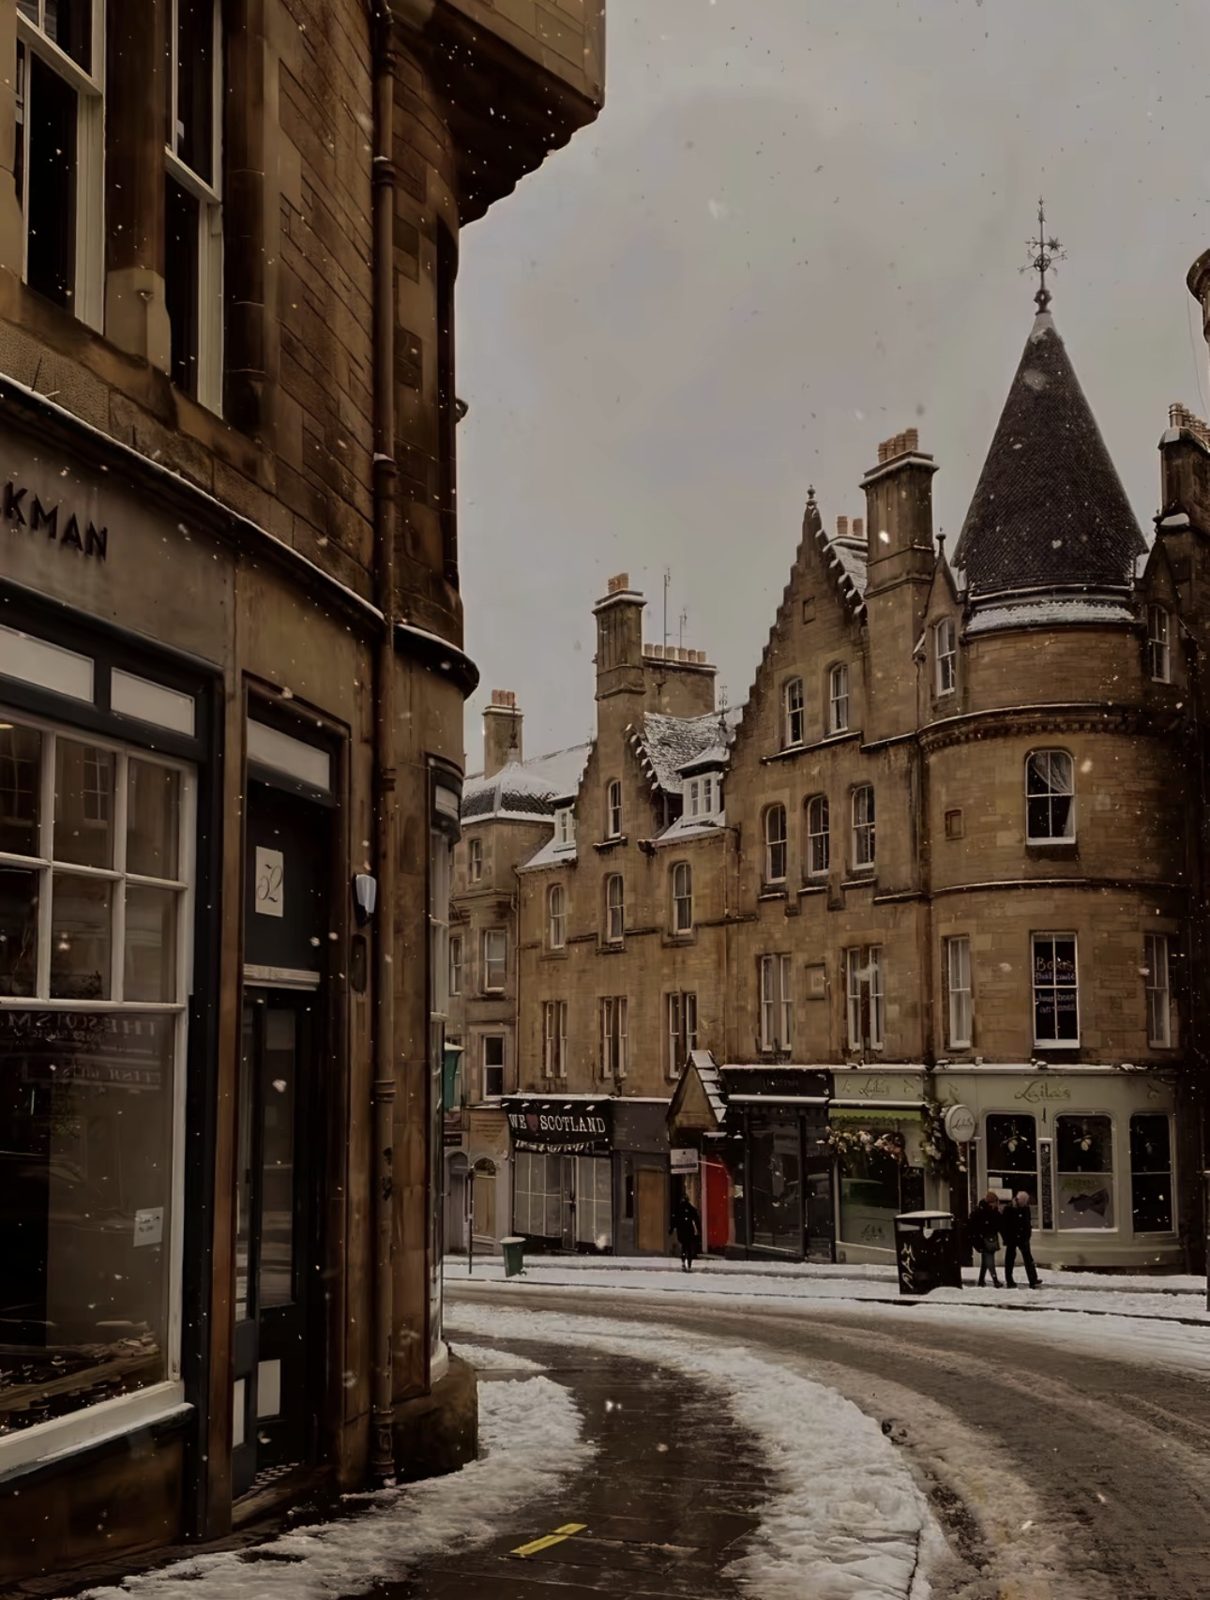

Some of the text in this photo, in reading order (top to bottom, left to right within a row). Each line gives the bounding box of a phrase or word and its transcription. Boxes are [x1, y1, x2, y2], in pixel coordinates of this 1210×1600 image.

[0, 481, 107, 561] KMAN
[508, 1113, 606, 1134] WE SCOTLAND
